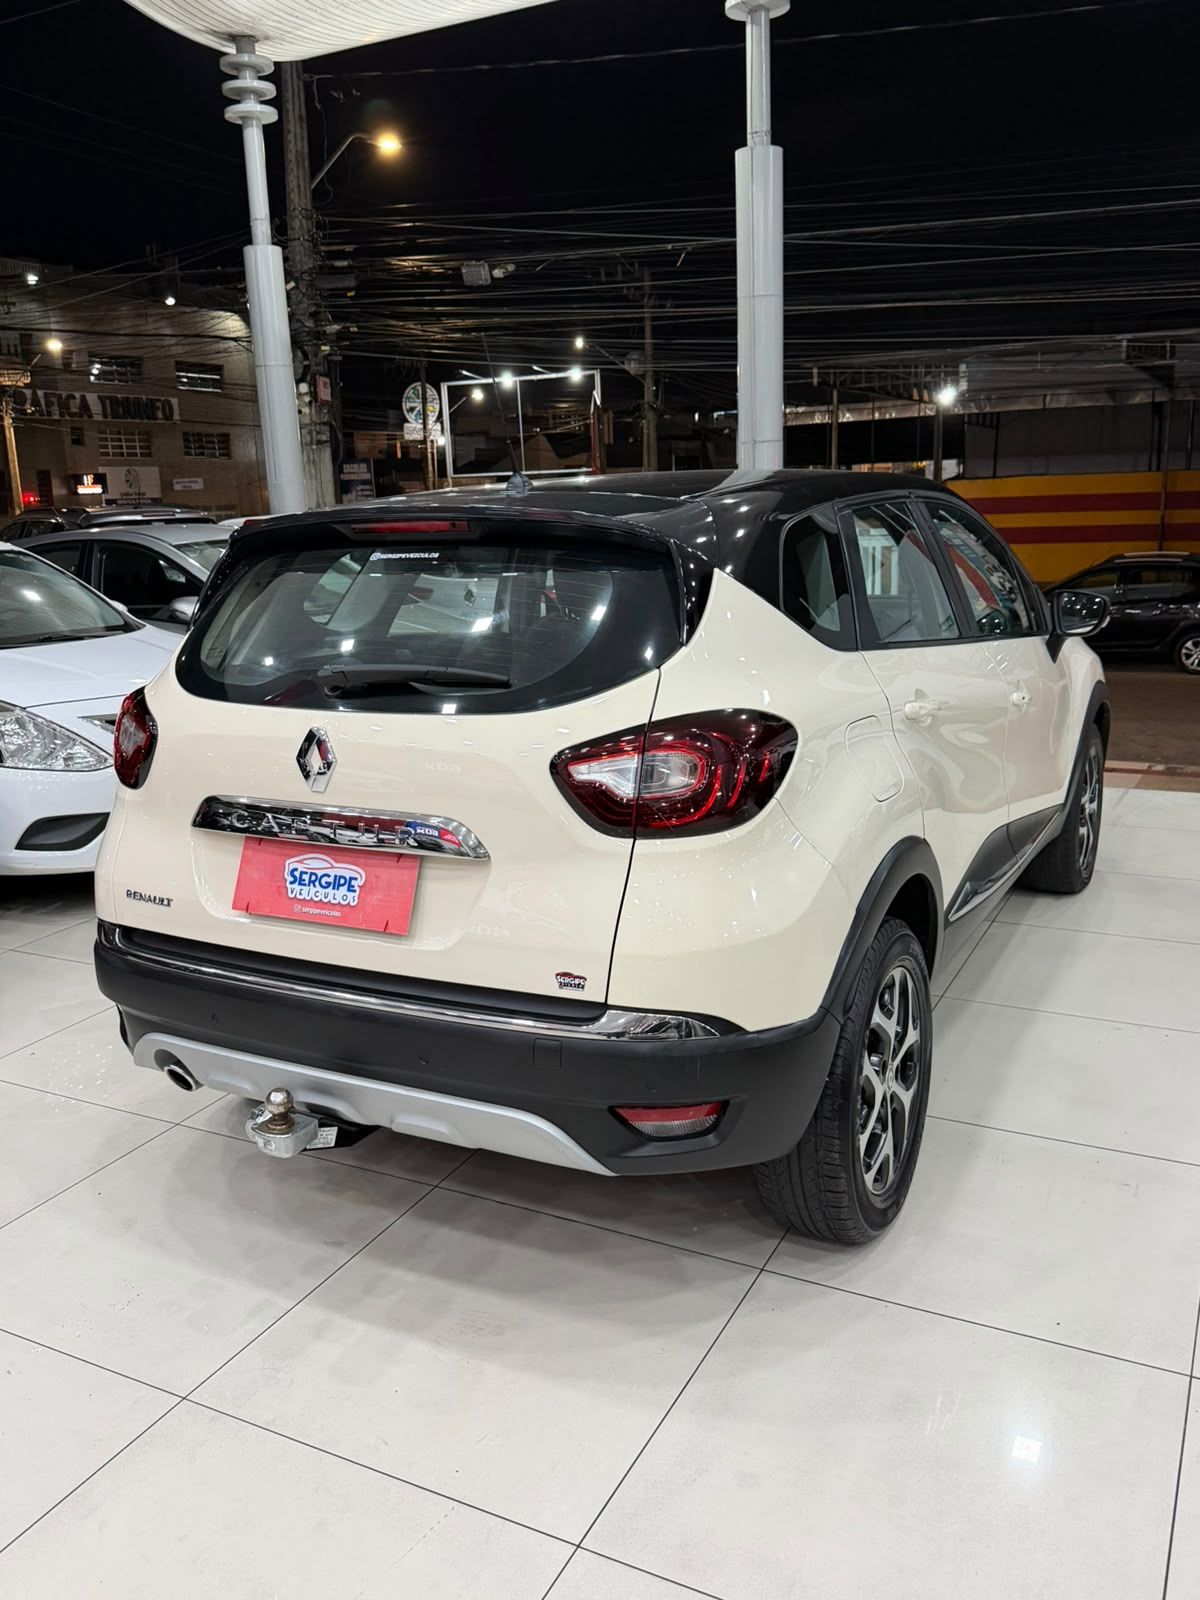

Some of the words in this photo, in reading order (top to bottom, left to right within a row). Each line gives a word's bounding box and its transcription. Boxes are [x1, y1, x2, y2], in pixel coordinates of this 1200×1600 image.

[97, 395, 174, 421] TRIUNFO
[289, 867, 358, 893] SERGIPE
[126, 889, 174, 907] RENAULT
